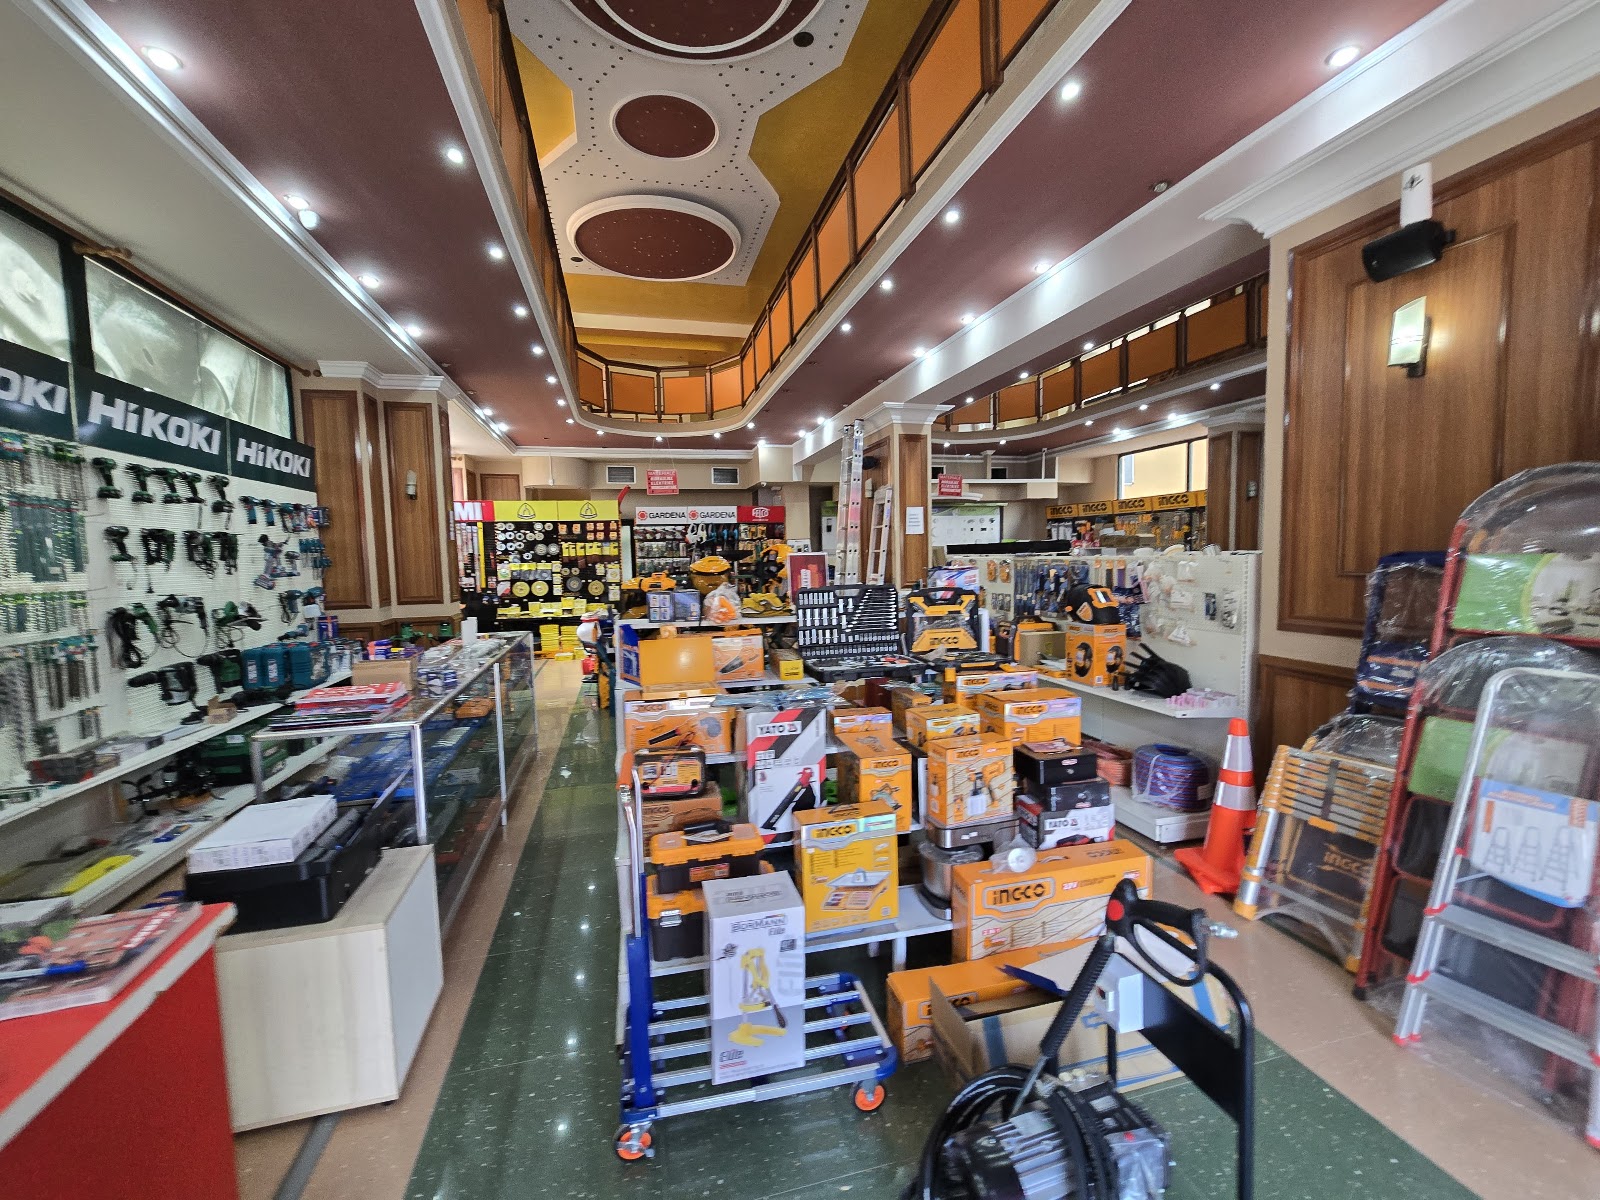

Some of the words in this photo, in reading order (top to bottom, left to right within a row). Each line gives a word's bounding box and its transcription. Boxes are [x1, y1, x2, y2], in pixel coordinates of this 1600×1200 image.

[0, 367, 67, 414] OKI
[699, 511, 736, 519] GARDENA
[758, 724, 786, 734] YATO
[730, 917, 787, 933] BORMANN
